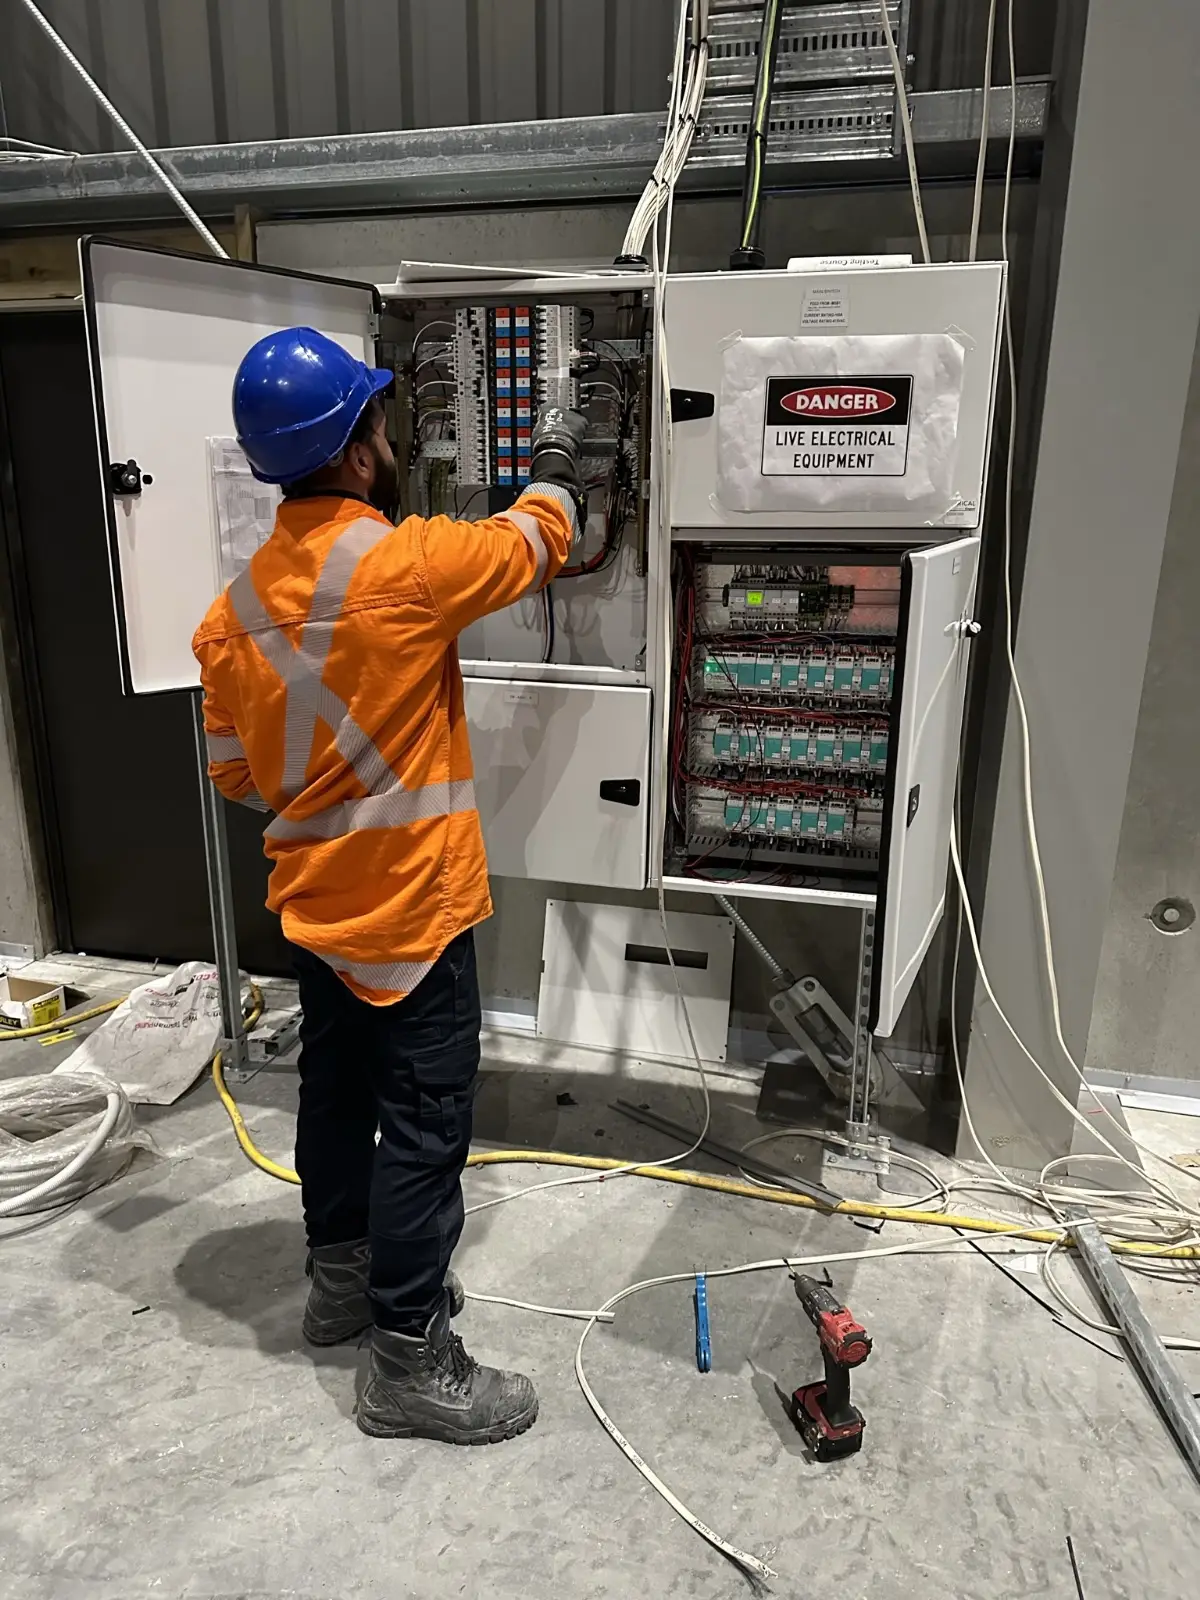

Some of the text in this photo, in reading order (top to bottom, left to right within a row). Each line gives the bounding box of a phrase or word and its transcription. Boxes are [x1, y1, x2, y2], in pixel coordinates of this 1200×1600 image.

[849, 258, 880, 266] Testing
[795, 393, 879, 410] DANGER
[775, 430, 896, 446] LIVE ELECTRICAL
[793, 453, 875, 469] EQUIPMENT
